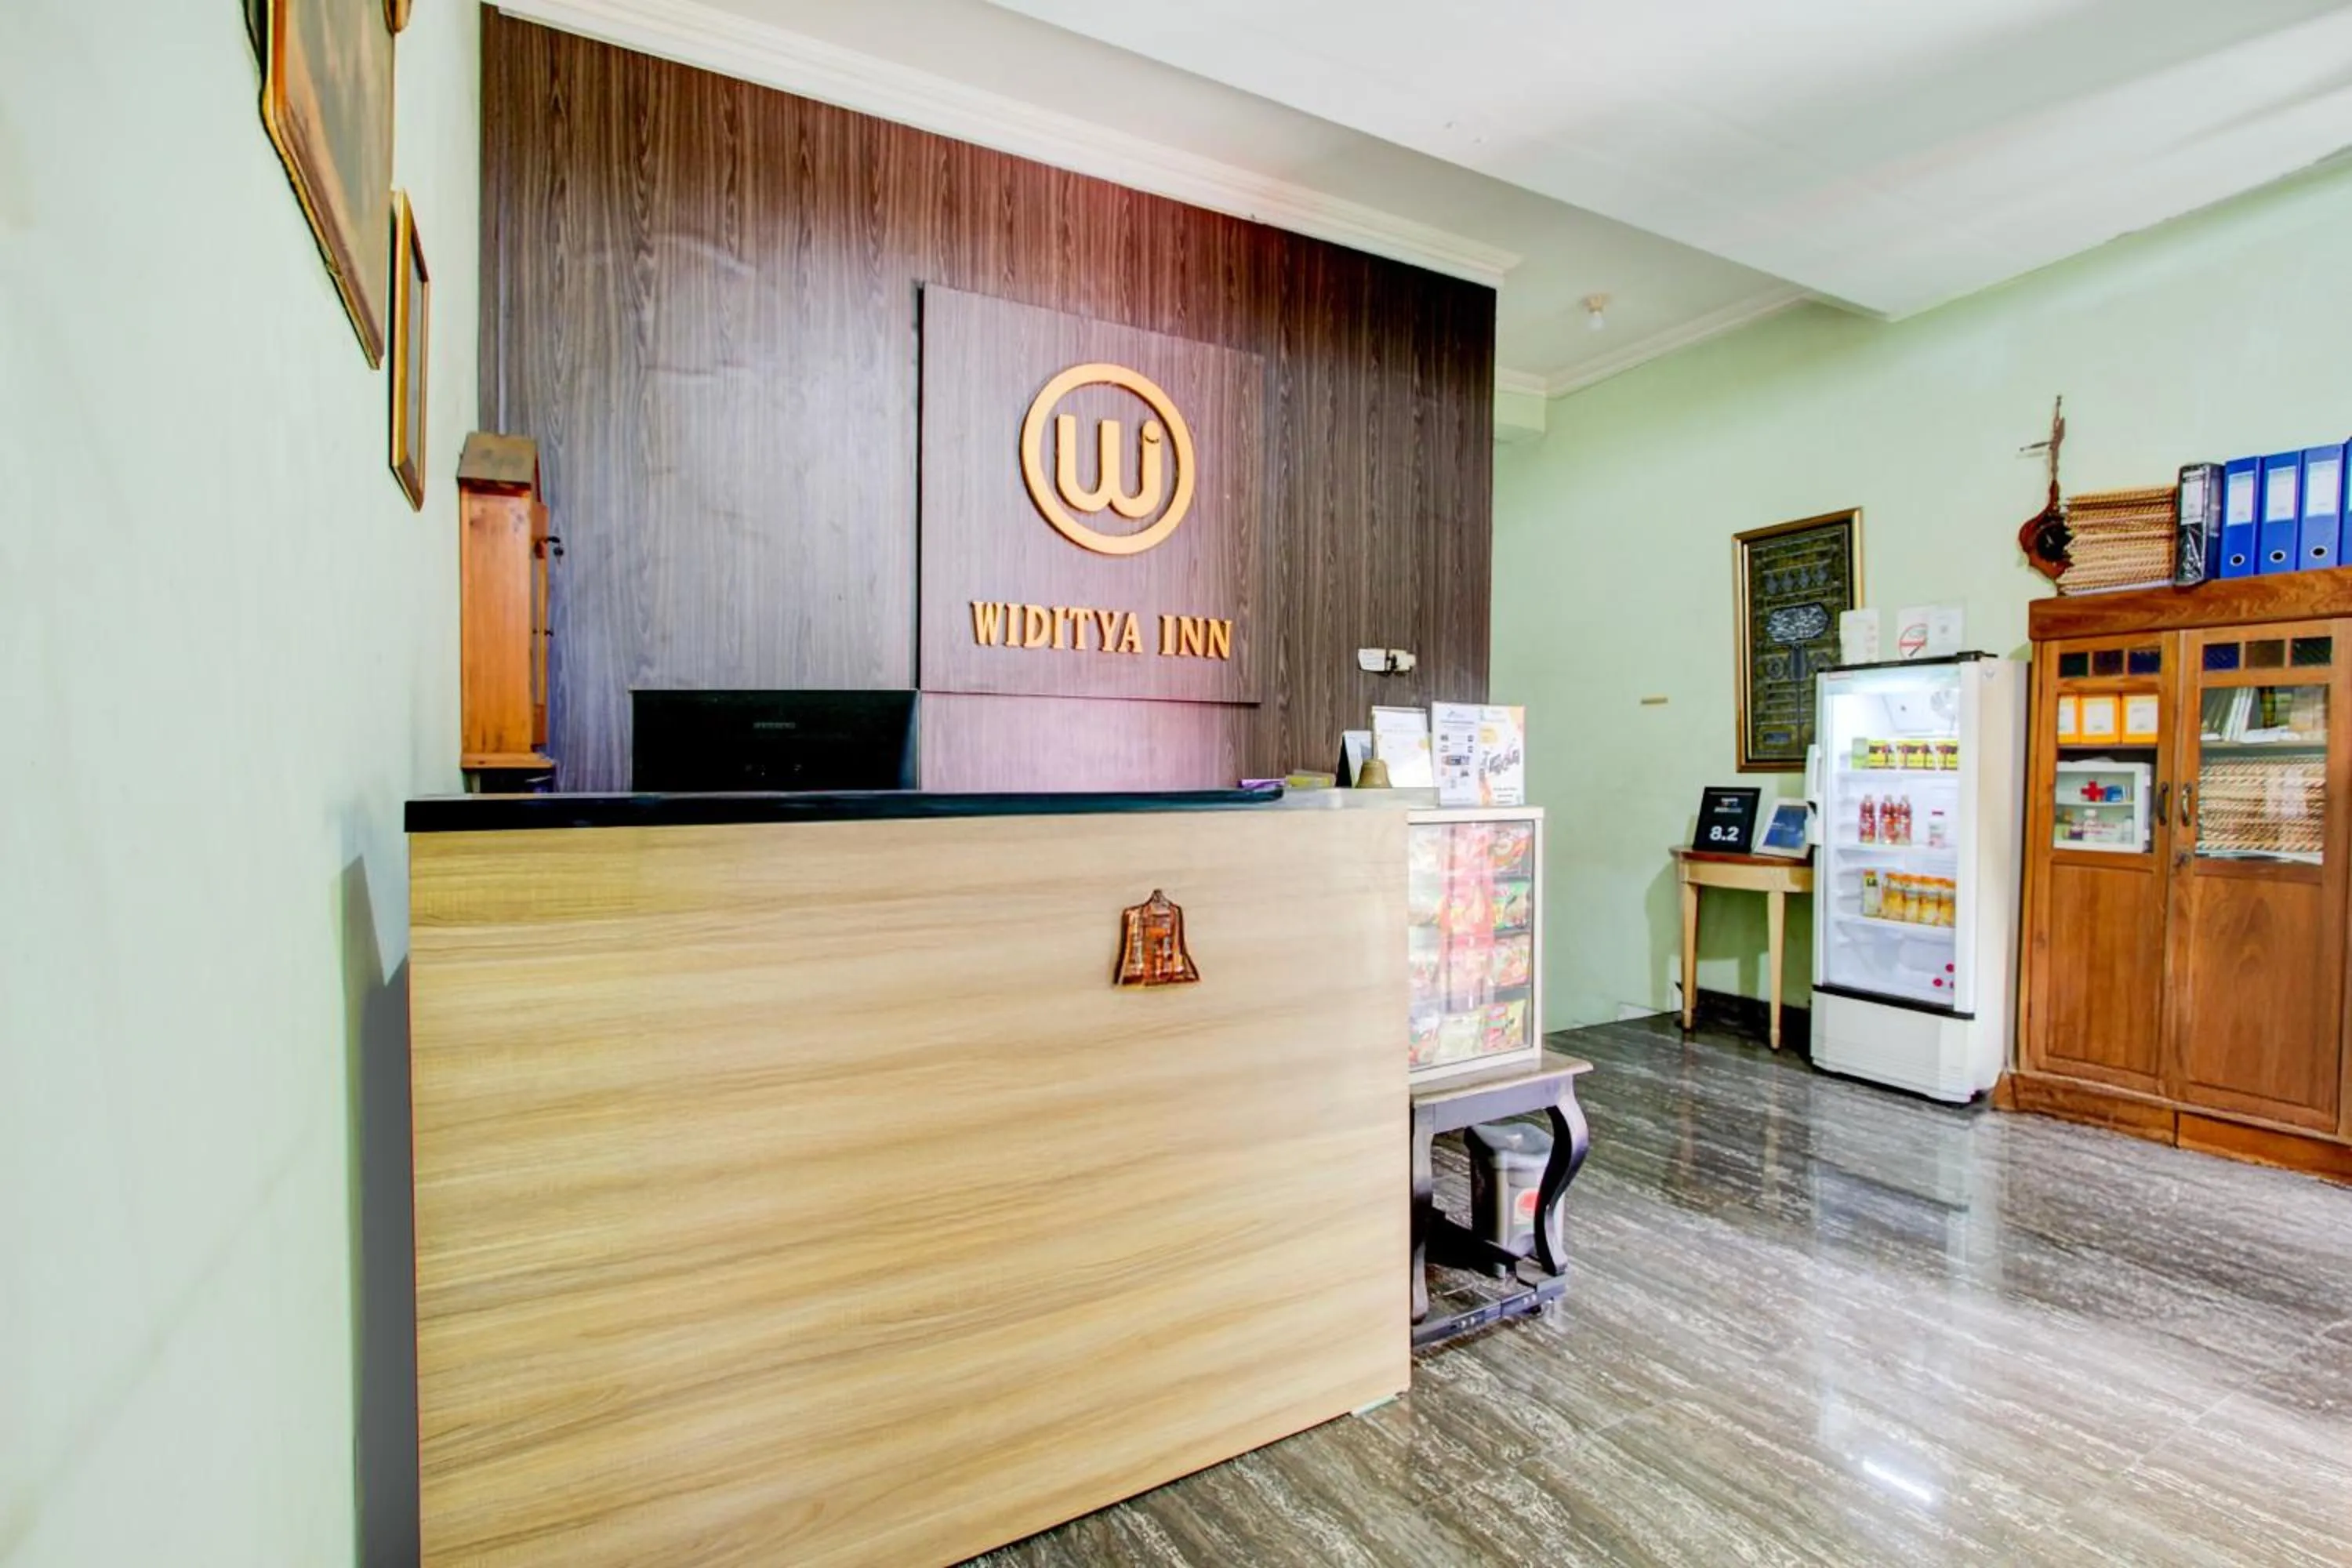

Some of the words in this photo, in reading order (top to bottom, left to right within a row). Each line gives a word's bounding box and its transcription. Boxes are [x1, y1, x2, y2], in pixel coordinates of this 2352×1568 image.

[970, 601, 1143, 654] WIDITYA
[1158, 614, 1233, 660] INN
[1709, 825, 1740, 841] 8.2
